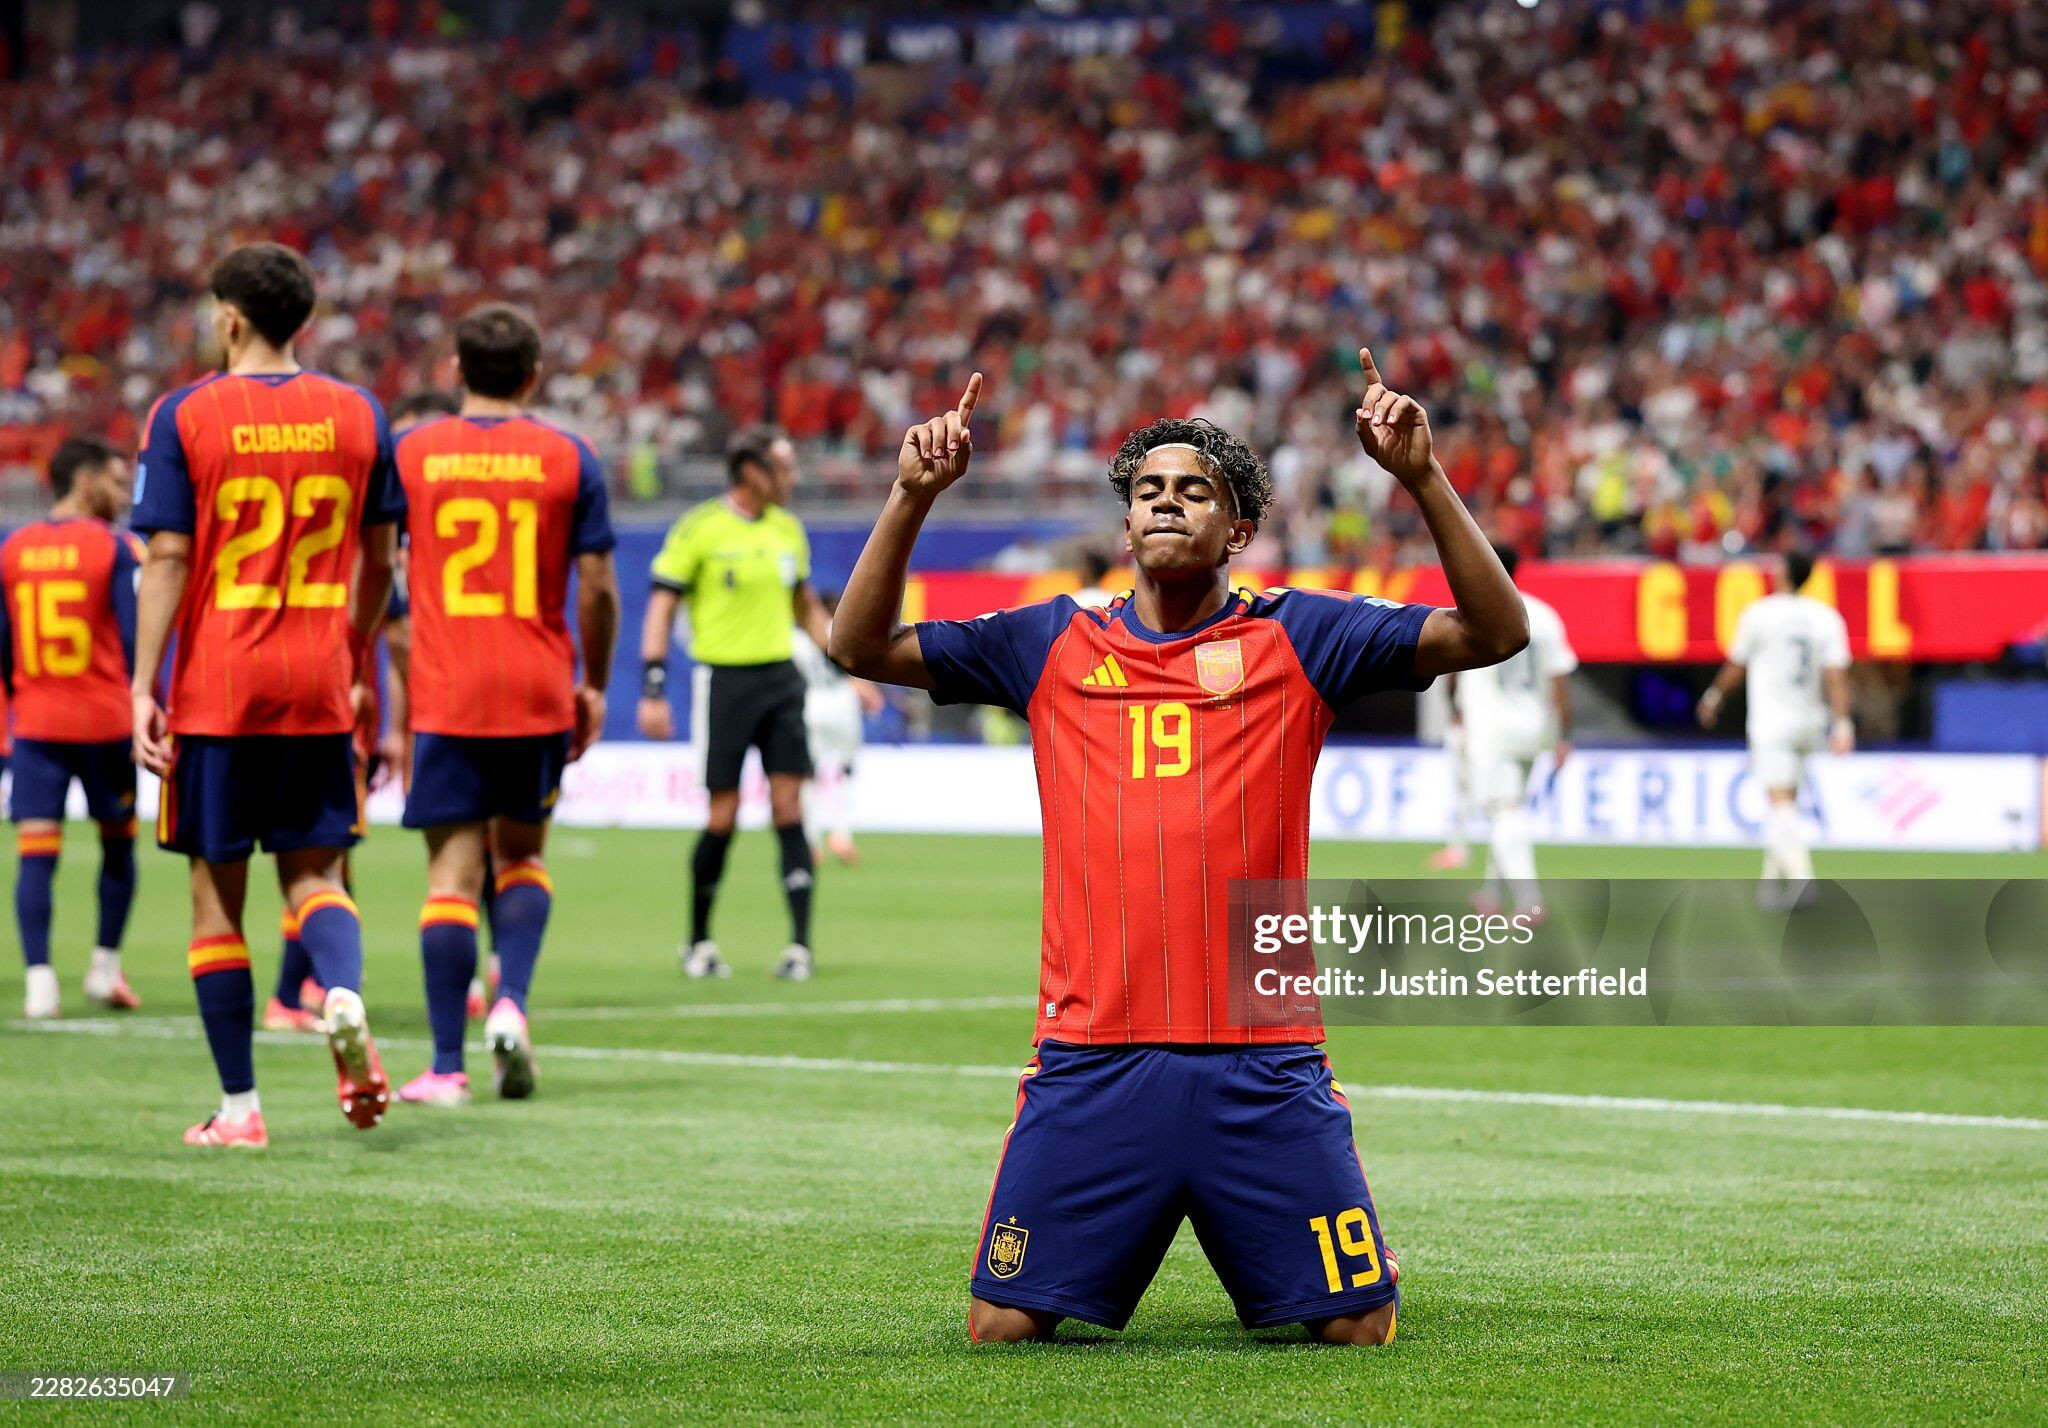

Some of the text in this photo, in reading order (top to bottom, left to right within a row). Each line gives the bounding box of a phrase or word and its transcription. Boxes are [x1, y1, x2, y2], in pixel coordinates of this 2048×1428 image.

[215, 475, 351, 611] 22
[436, 497, 538, 618] 21
[15, 580, 91, 677] 15
[1129, 702, 1192, 779] 19
[1309, 1207, 1382, 1294] 19
